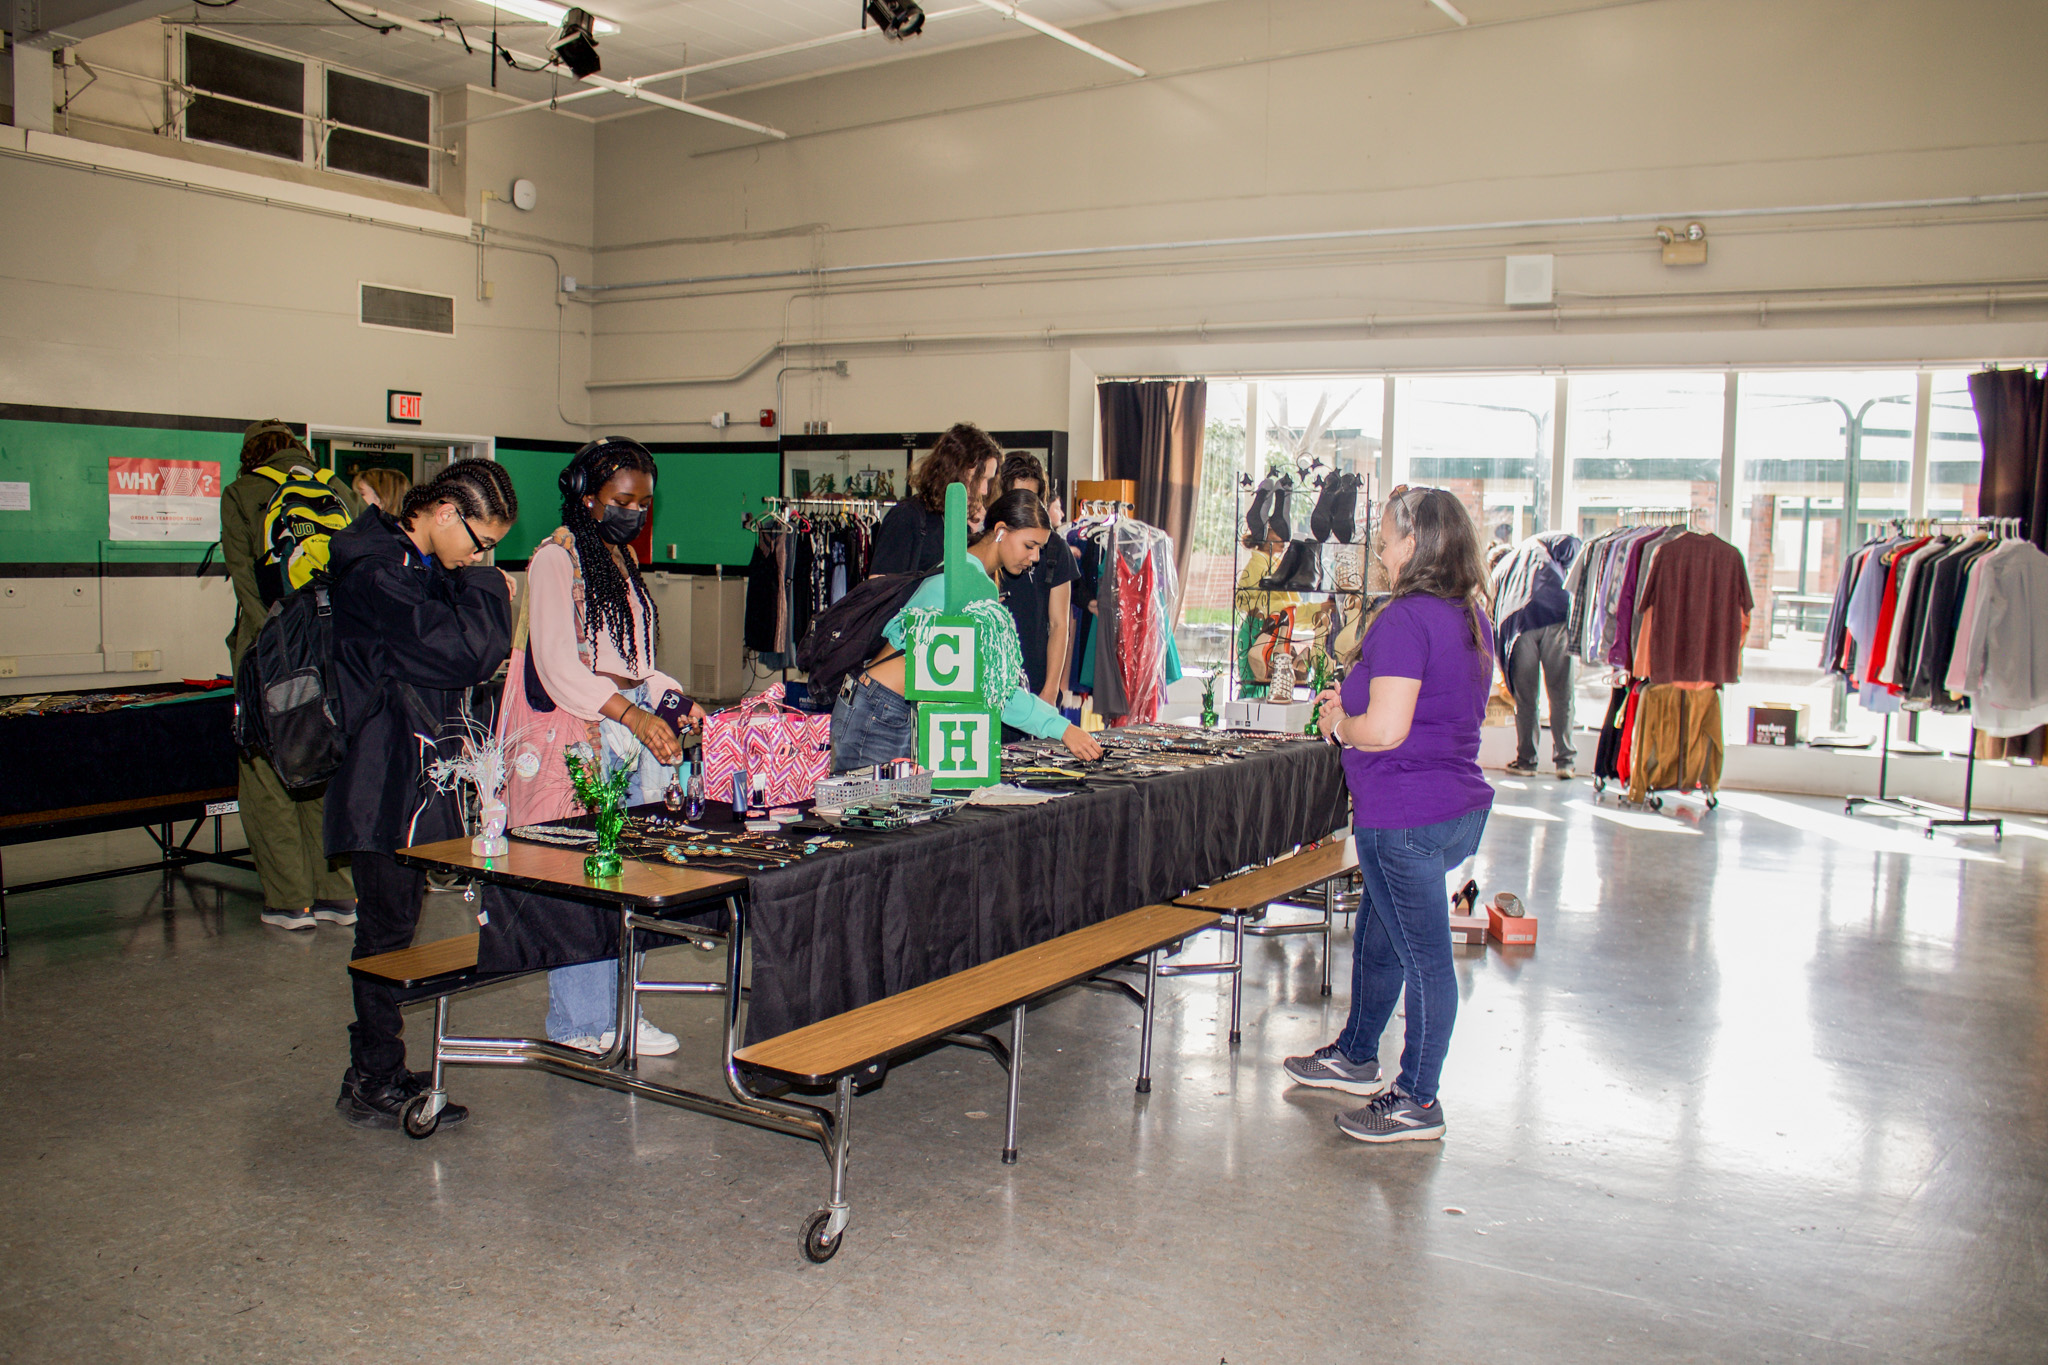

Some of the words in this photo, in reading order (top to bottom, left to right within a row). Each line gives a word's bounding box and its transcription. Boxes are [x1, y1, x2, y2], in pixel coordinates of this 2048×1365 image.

[399, 395, 421, 418] EXIT
[352, 441, 396, 451] Principal
[116, 471, 160, 491] WHY
[926, 633, 960, 687] C
[938, 720, 978, 771] H
